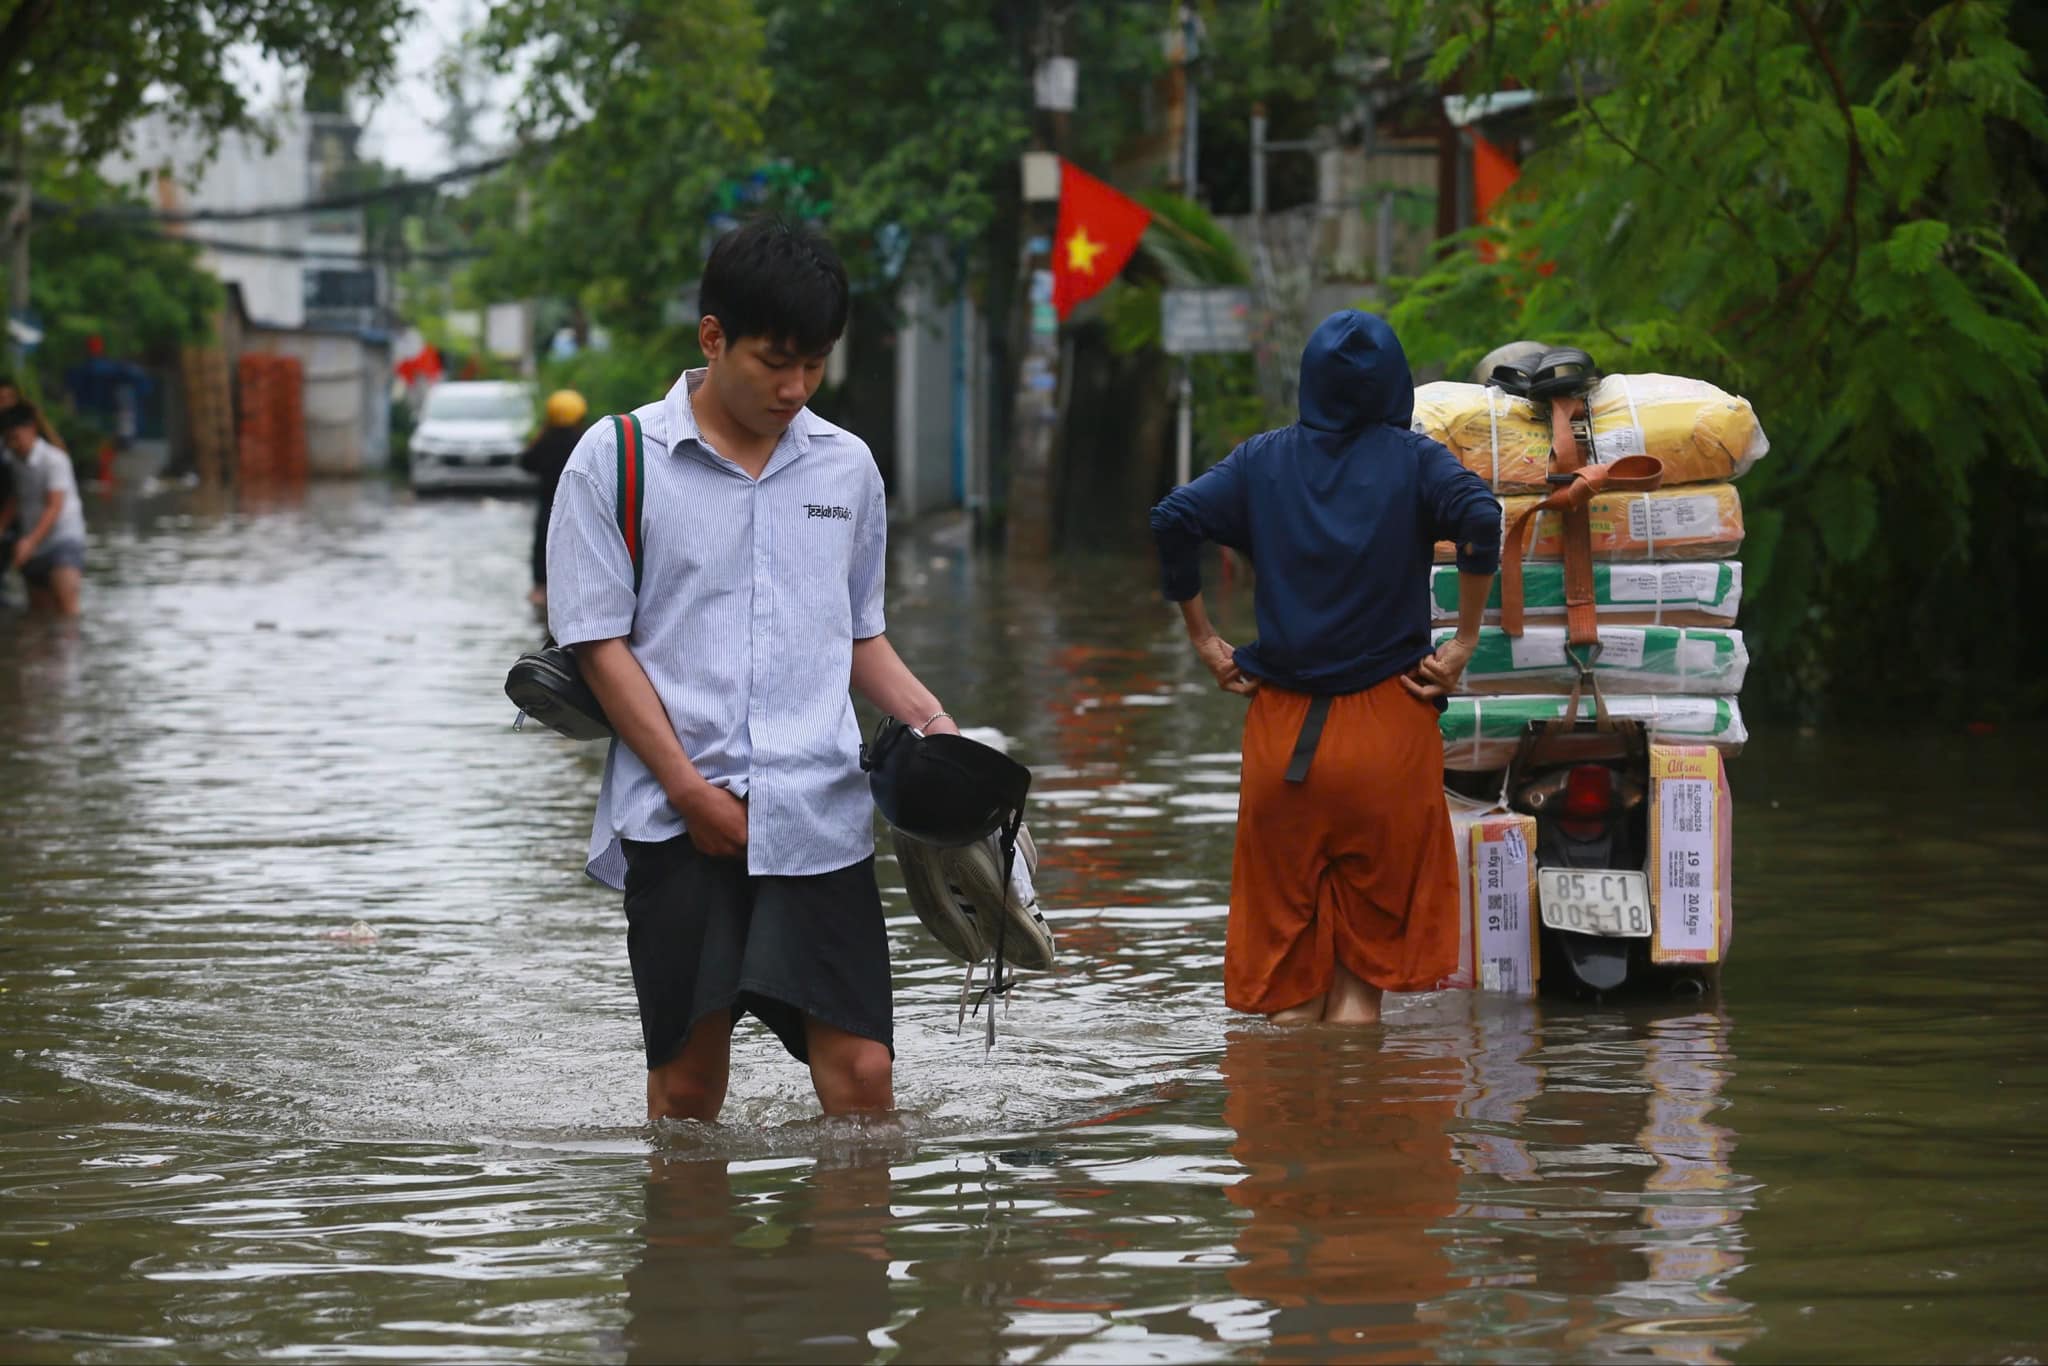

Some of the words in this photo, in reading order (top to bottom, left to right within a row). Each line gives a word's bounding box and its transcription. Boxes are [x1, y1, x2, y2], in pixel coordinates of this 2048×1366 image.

[1488, 856, 1500, 868] Kg
[1687, 851, 1700, 866] 19
[1488, 869, 1499, 888] 20.0
[1688, 893, 1700, 913] 20.0
[1488, 915, 1500, 931] 19
[1686, 914, 1700, 927] Kg
